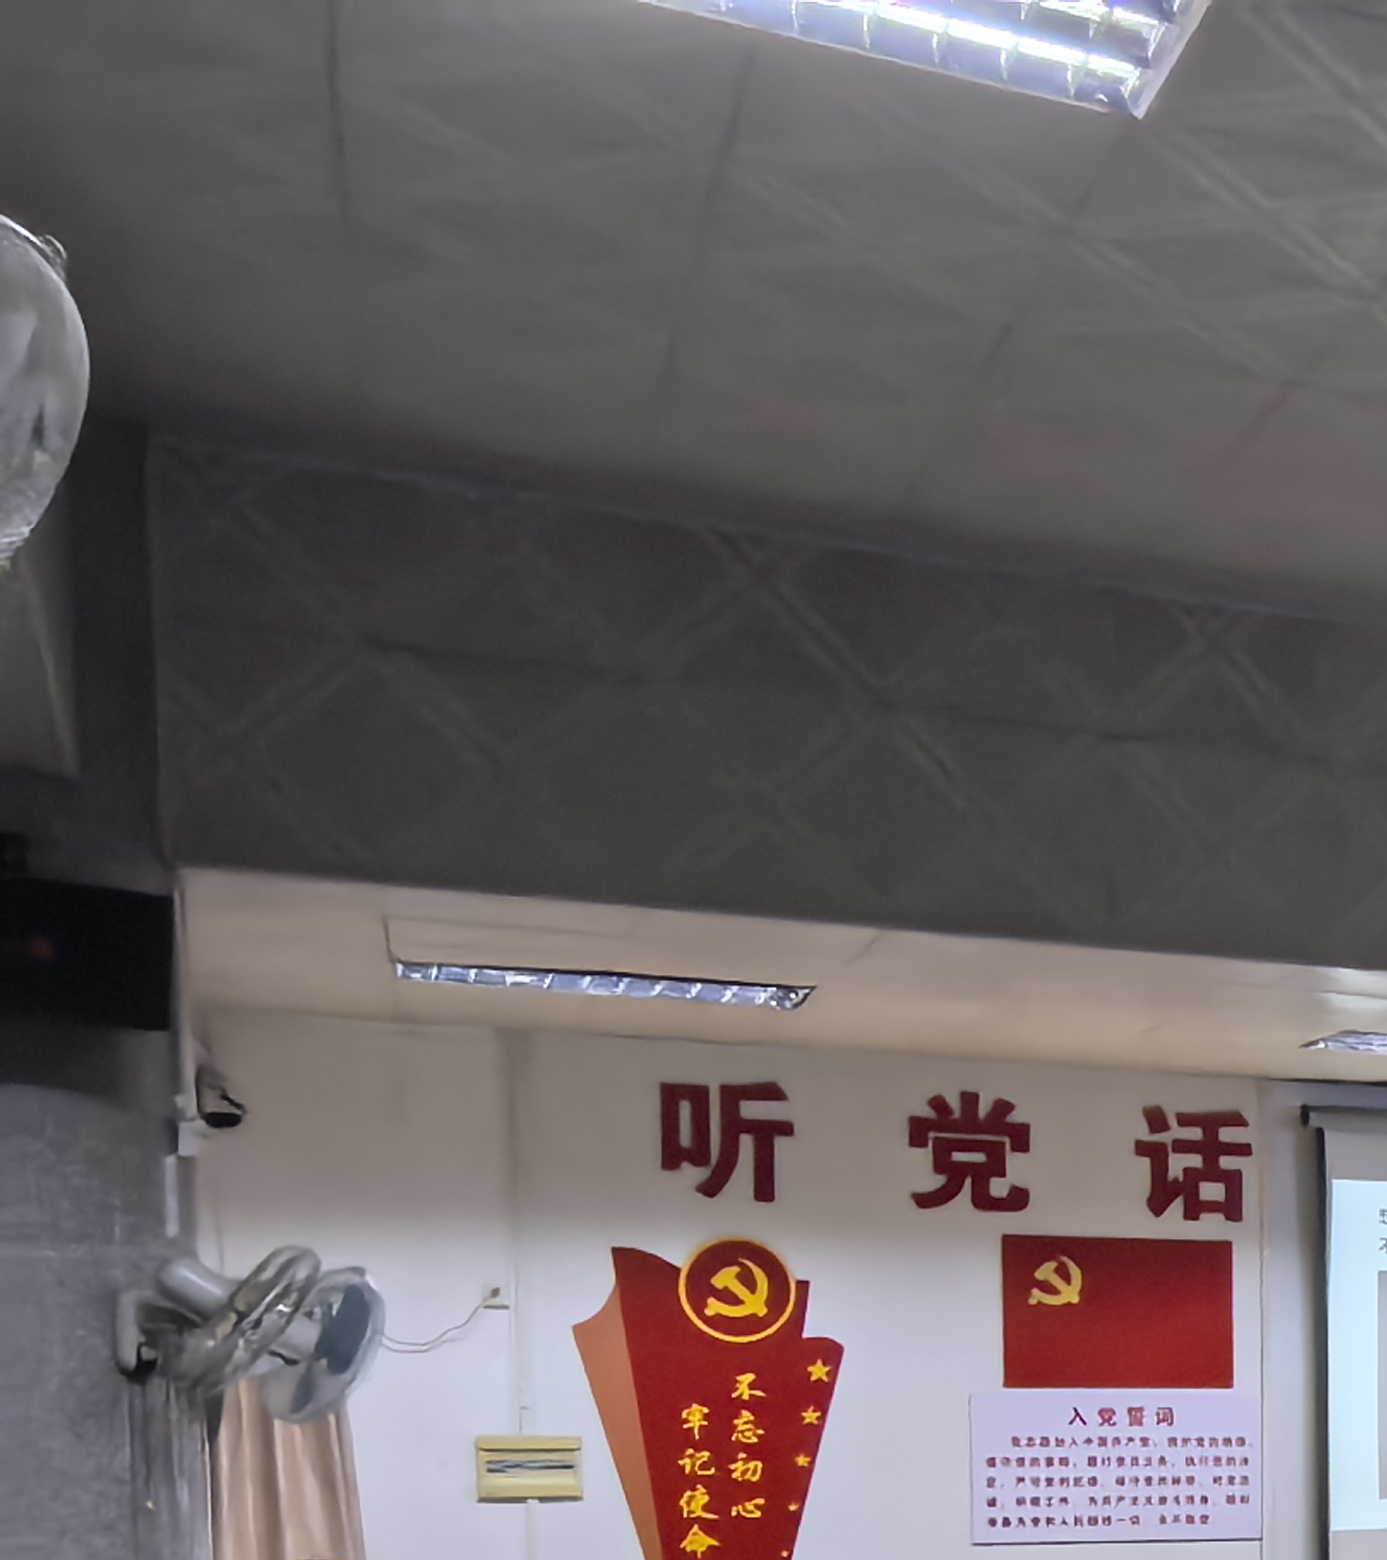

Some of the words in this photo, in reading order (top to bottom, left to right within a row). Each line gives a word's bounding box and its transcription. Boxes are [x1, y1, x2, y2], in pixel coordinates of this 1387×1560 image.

[659, 1081, 1252, 1222] 听党话
[678, 1403, 721, 1559] 牢记使命
[728, 1373, 767, 1518] 不忘初心
